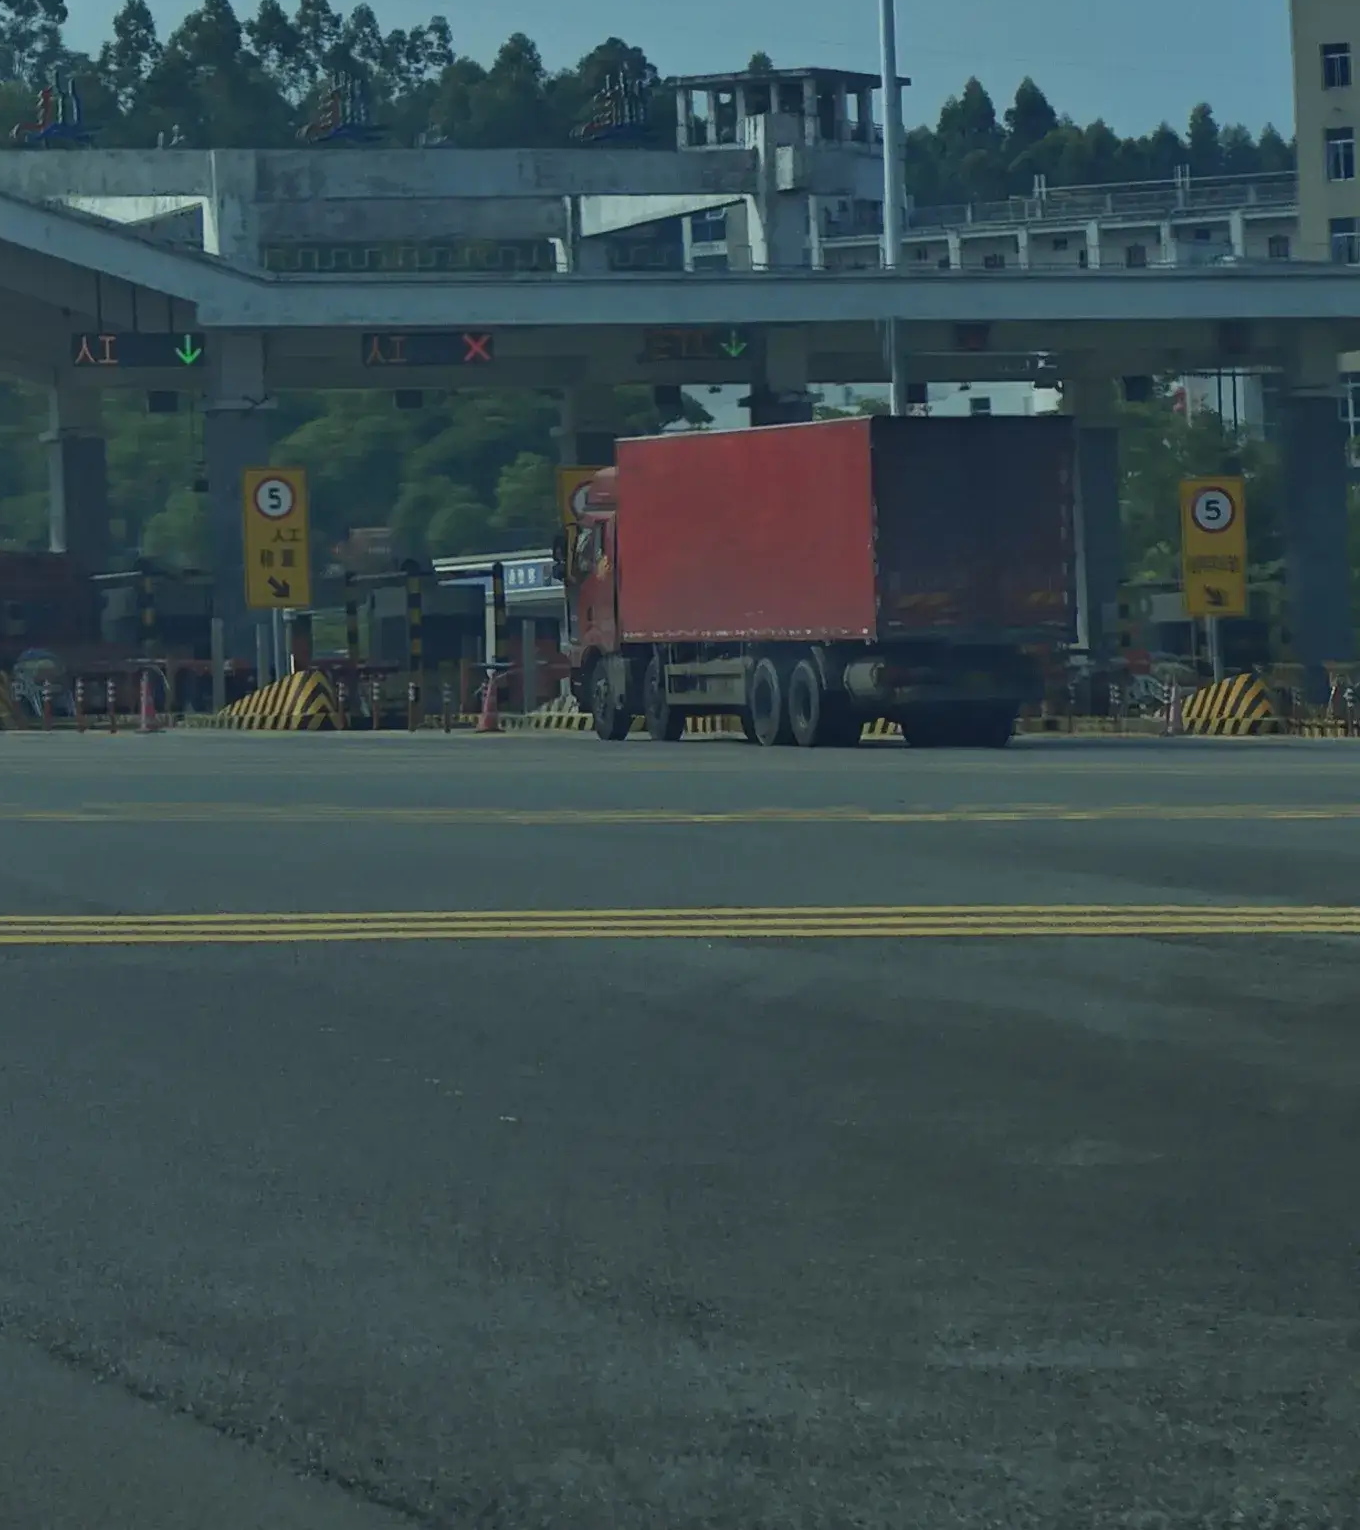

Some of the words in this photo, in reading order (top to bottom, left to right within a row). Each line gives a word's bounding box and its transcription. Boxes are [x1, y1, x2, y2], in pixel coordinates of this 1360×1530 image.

[74, 334, 119, 364] 人工
[365, 335, 408, 364] 人工
[267, 487, 282, 509] 5
[1204, 500, 1222, 521] 5
[271, 528, 303, 543] 人工
